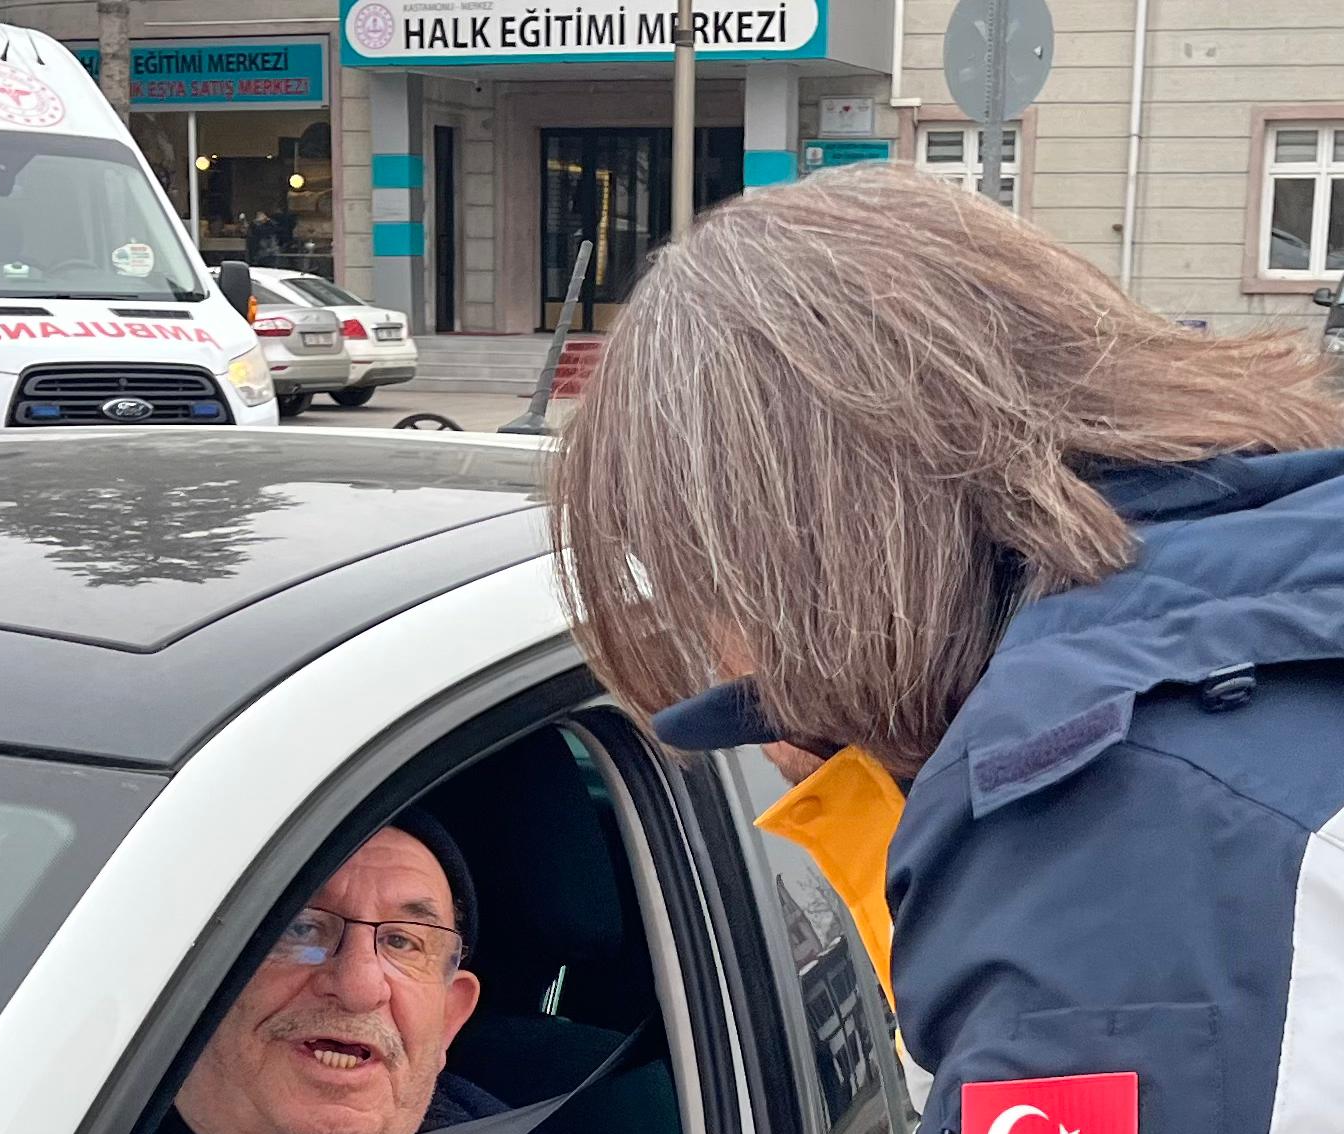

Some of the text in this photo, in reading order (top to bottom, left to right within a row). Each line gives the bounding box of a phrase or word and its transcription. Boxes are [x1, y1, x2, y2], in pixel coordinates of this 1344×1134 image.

[404, 16, 491, 49] HALK
[500, 6, 625, 47] EĞİTİMİ
[133, 48, 289, 75] EĞİTİMİ MERKEZİ
